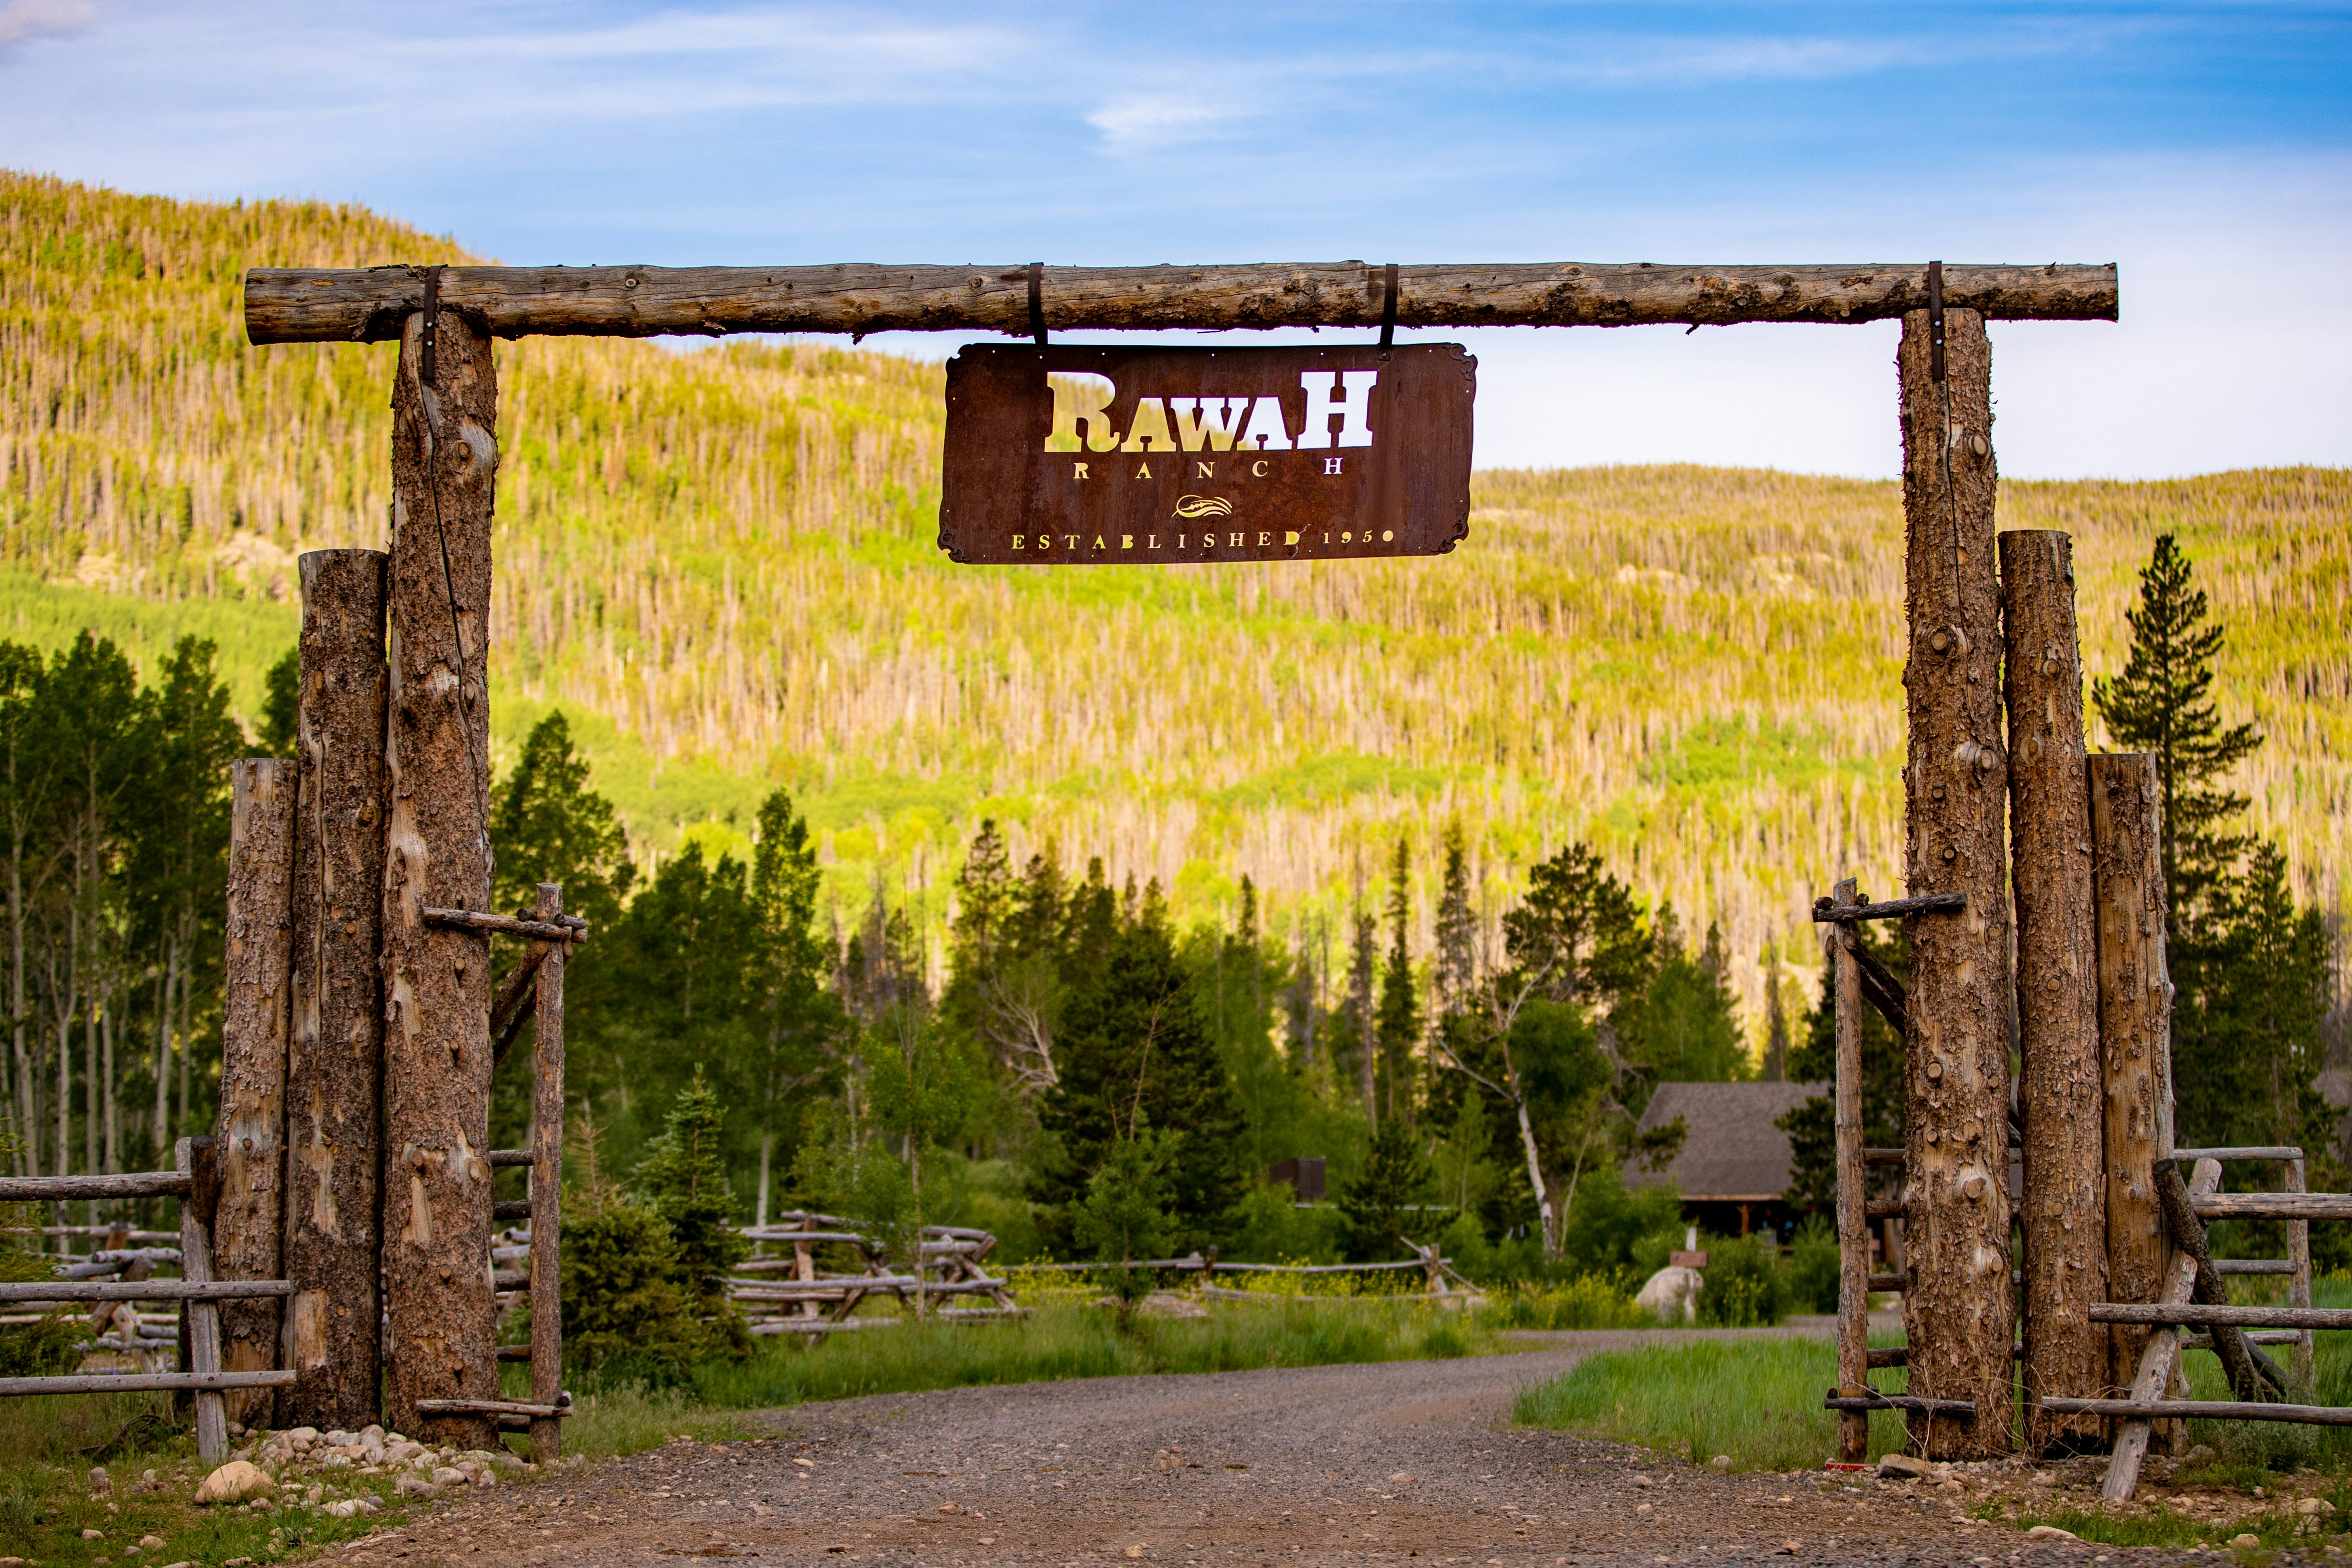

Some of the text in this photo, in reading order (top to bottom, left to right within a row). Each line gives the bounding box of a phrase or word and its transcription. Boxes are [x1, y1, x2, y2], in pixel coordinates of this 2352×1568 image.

[1044, 371, 1377, 452] RAWAH
[1073, 458, 1343, 479] RANCH
[1012, 530, 1394, 549] ESTABLISHED 1950
